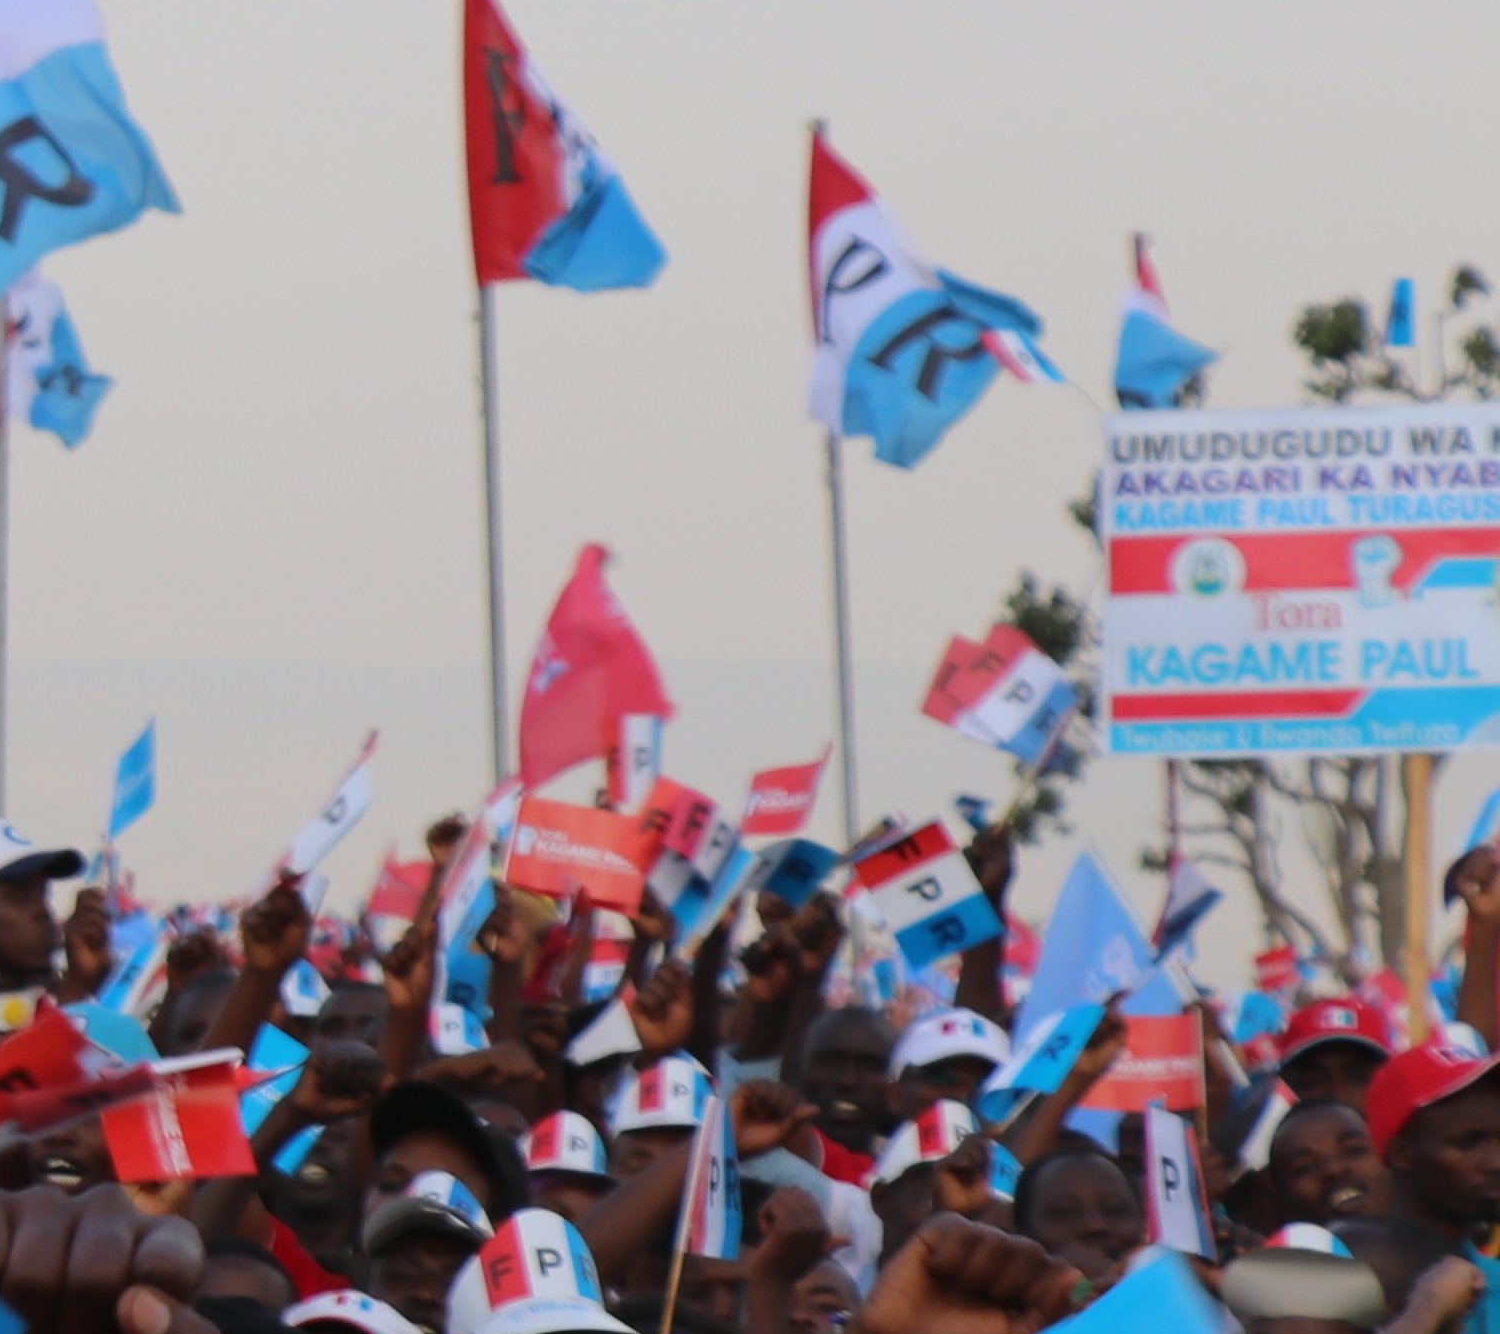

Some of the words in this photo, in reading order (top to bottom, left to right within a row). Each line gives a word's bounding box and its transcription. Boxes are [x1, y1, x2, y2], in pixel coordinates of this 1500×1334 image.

[1112, 426, 1392, 465] UMUDUGUDU
[1410, 425, 1474, 456] WA
[1115, 467, 1302, 496] AKAGARI
[1319, 465, 1375, 491] KA
[1114, 499, 1248, 530] KAGAME
[1258, 497, 1336, 527] PAUL
[1255, 594, 1343, 631] Tora
[1126, 641, 1342, 686] KAGAME
[1360, 637, 1479, 680] PAUL
